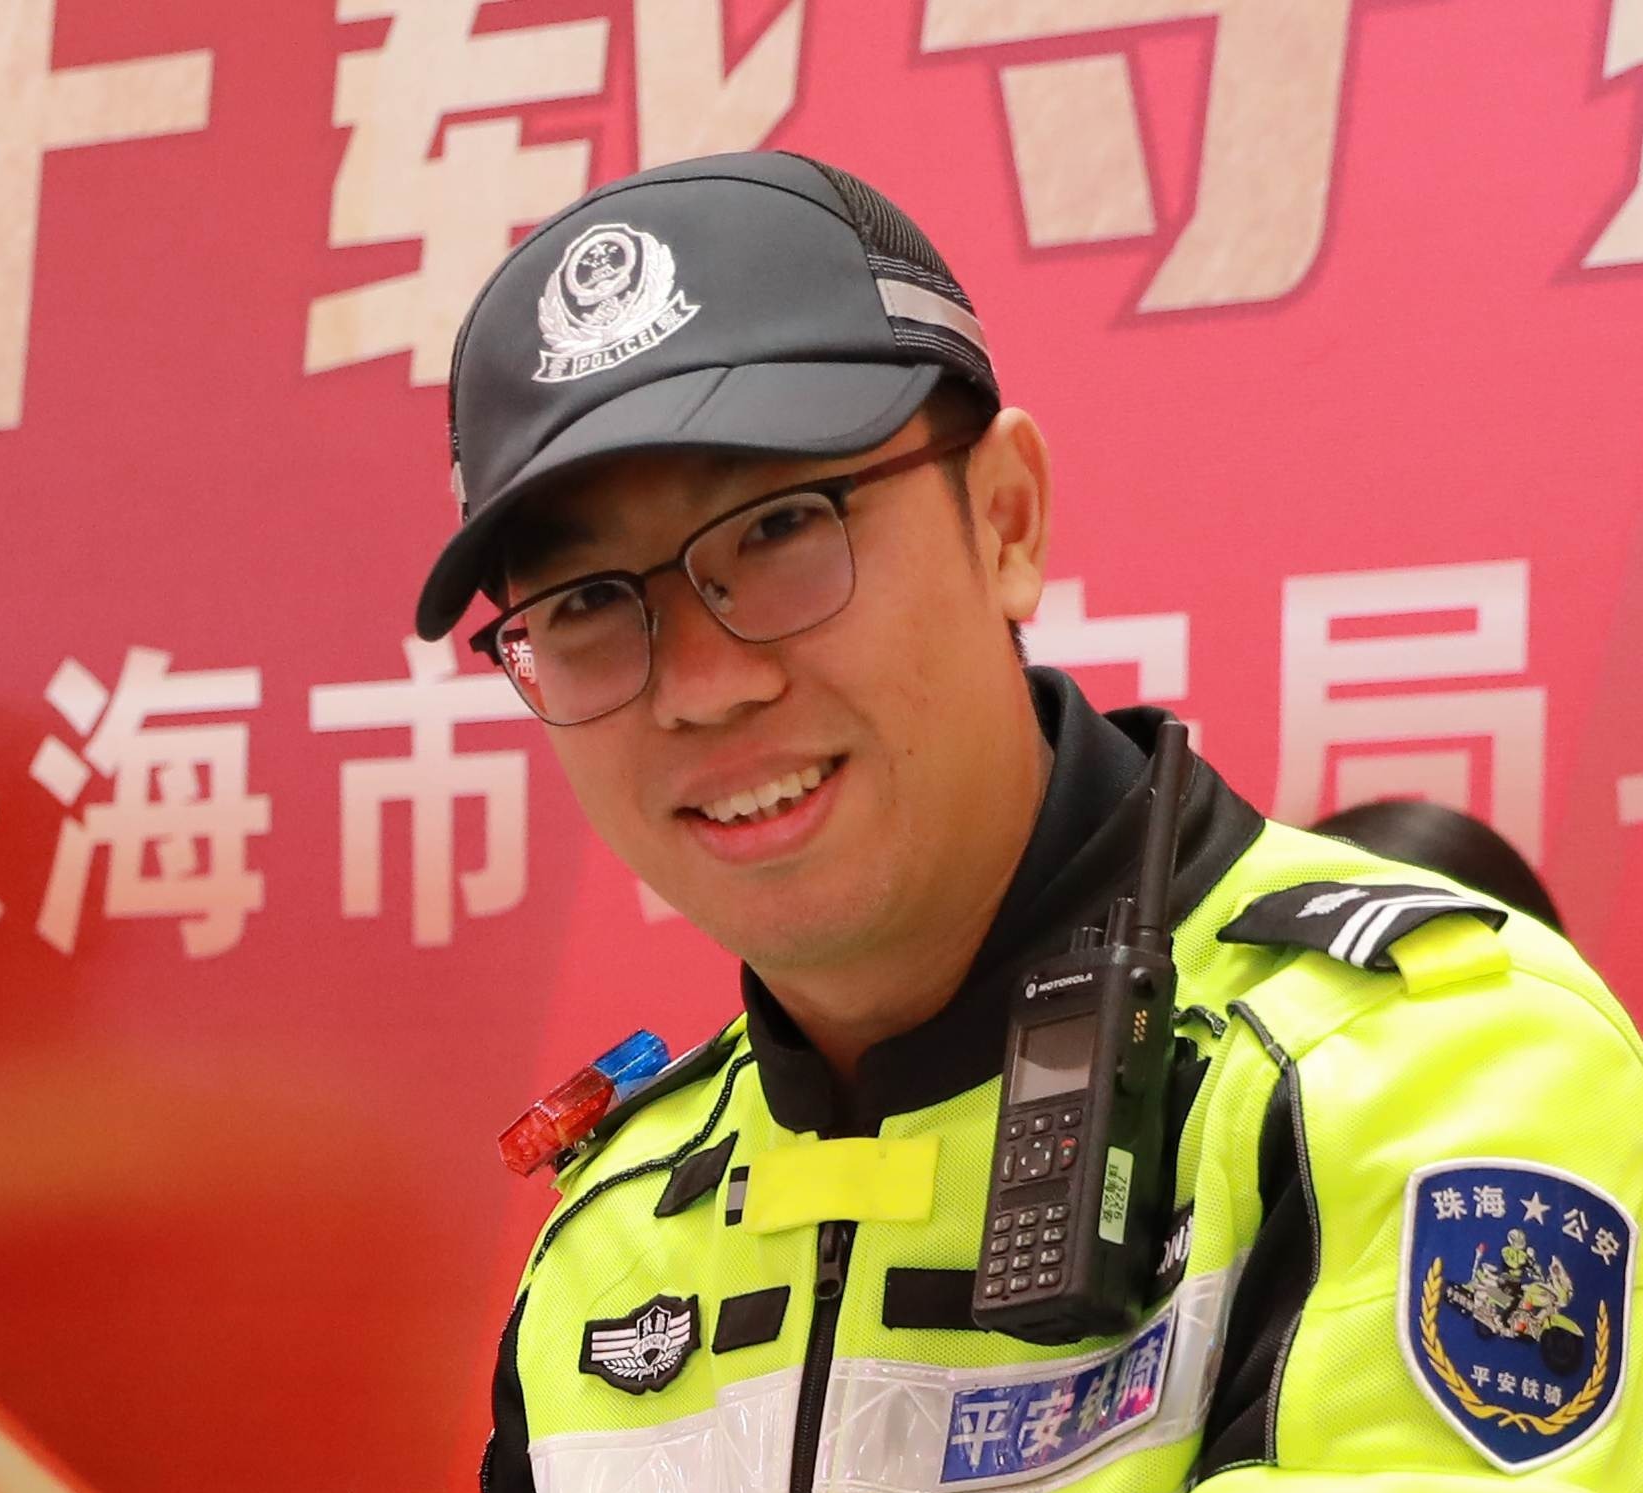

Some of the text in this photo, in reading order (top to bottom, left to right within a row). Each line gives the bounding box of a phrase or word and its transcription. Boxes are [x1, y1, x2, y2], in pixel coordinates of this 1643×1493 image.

[577, 327, 656, 374] POLICE
[1037, 972, 1094, 993] MOTOROLA
[1470, 1364, 1564, 1408] 平安铁骑
